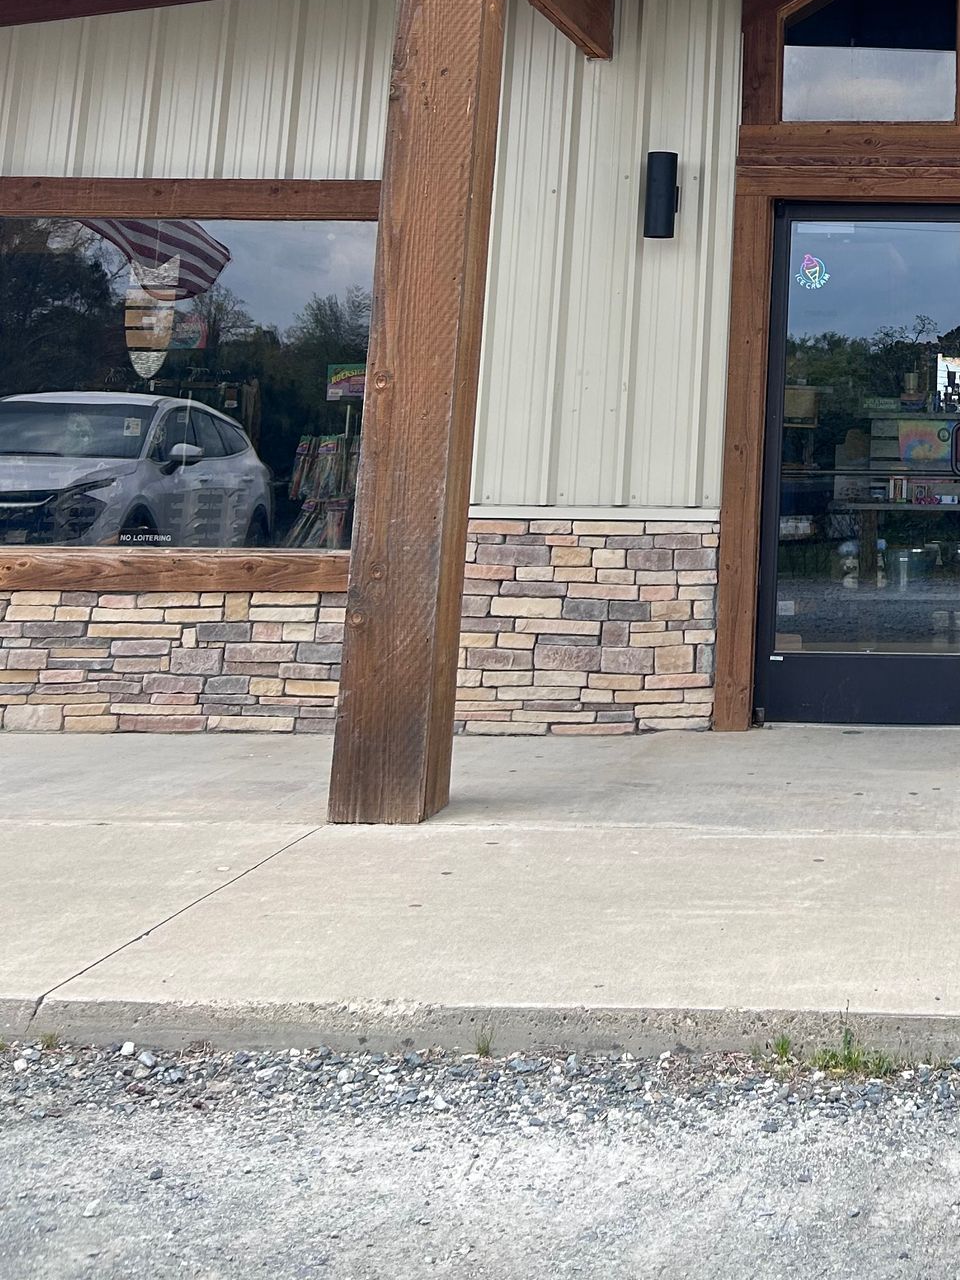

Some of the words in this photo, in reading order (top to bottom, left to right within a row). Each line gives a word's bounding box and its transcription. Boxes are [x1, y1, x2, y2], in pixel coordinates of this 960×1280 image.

[795, 273, 806, 286] ICE
[806, 273, 831, 290] CREAM
[133, 534, 172, 542] LOITERING
